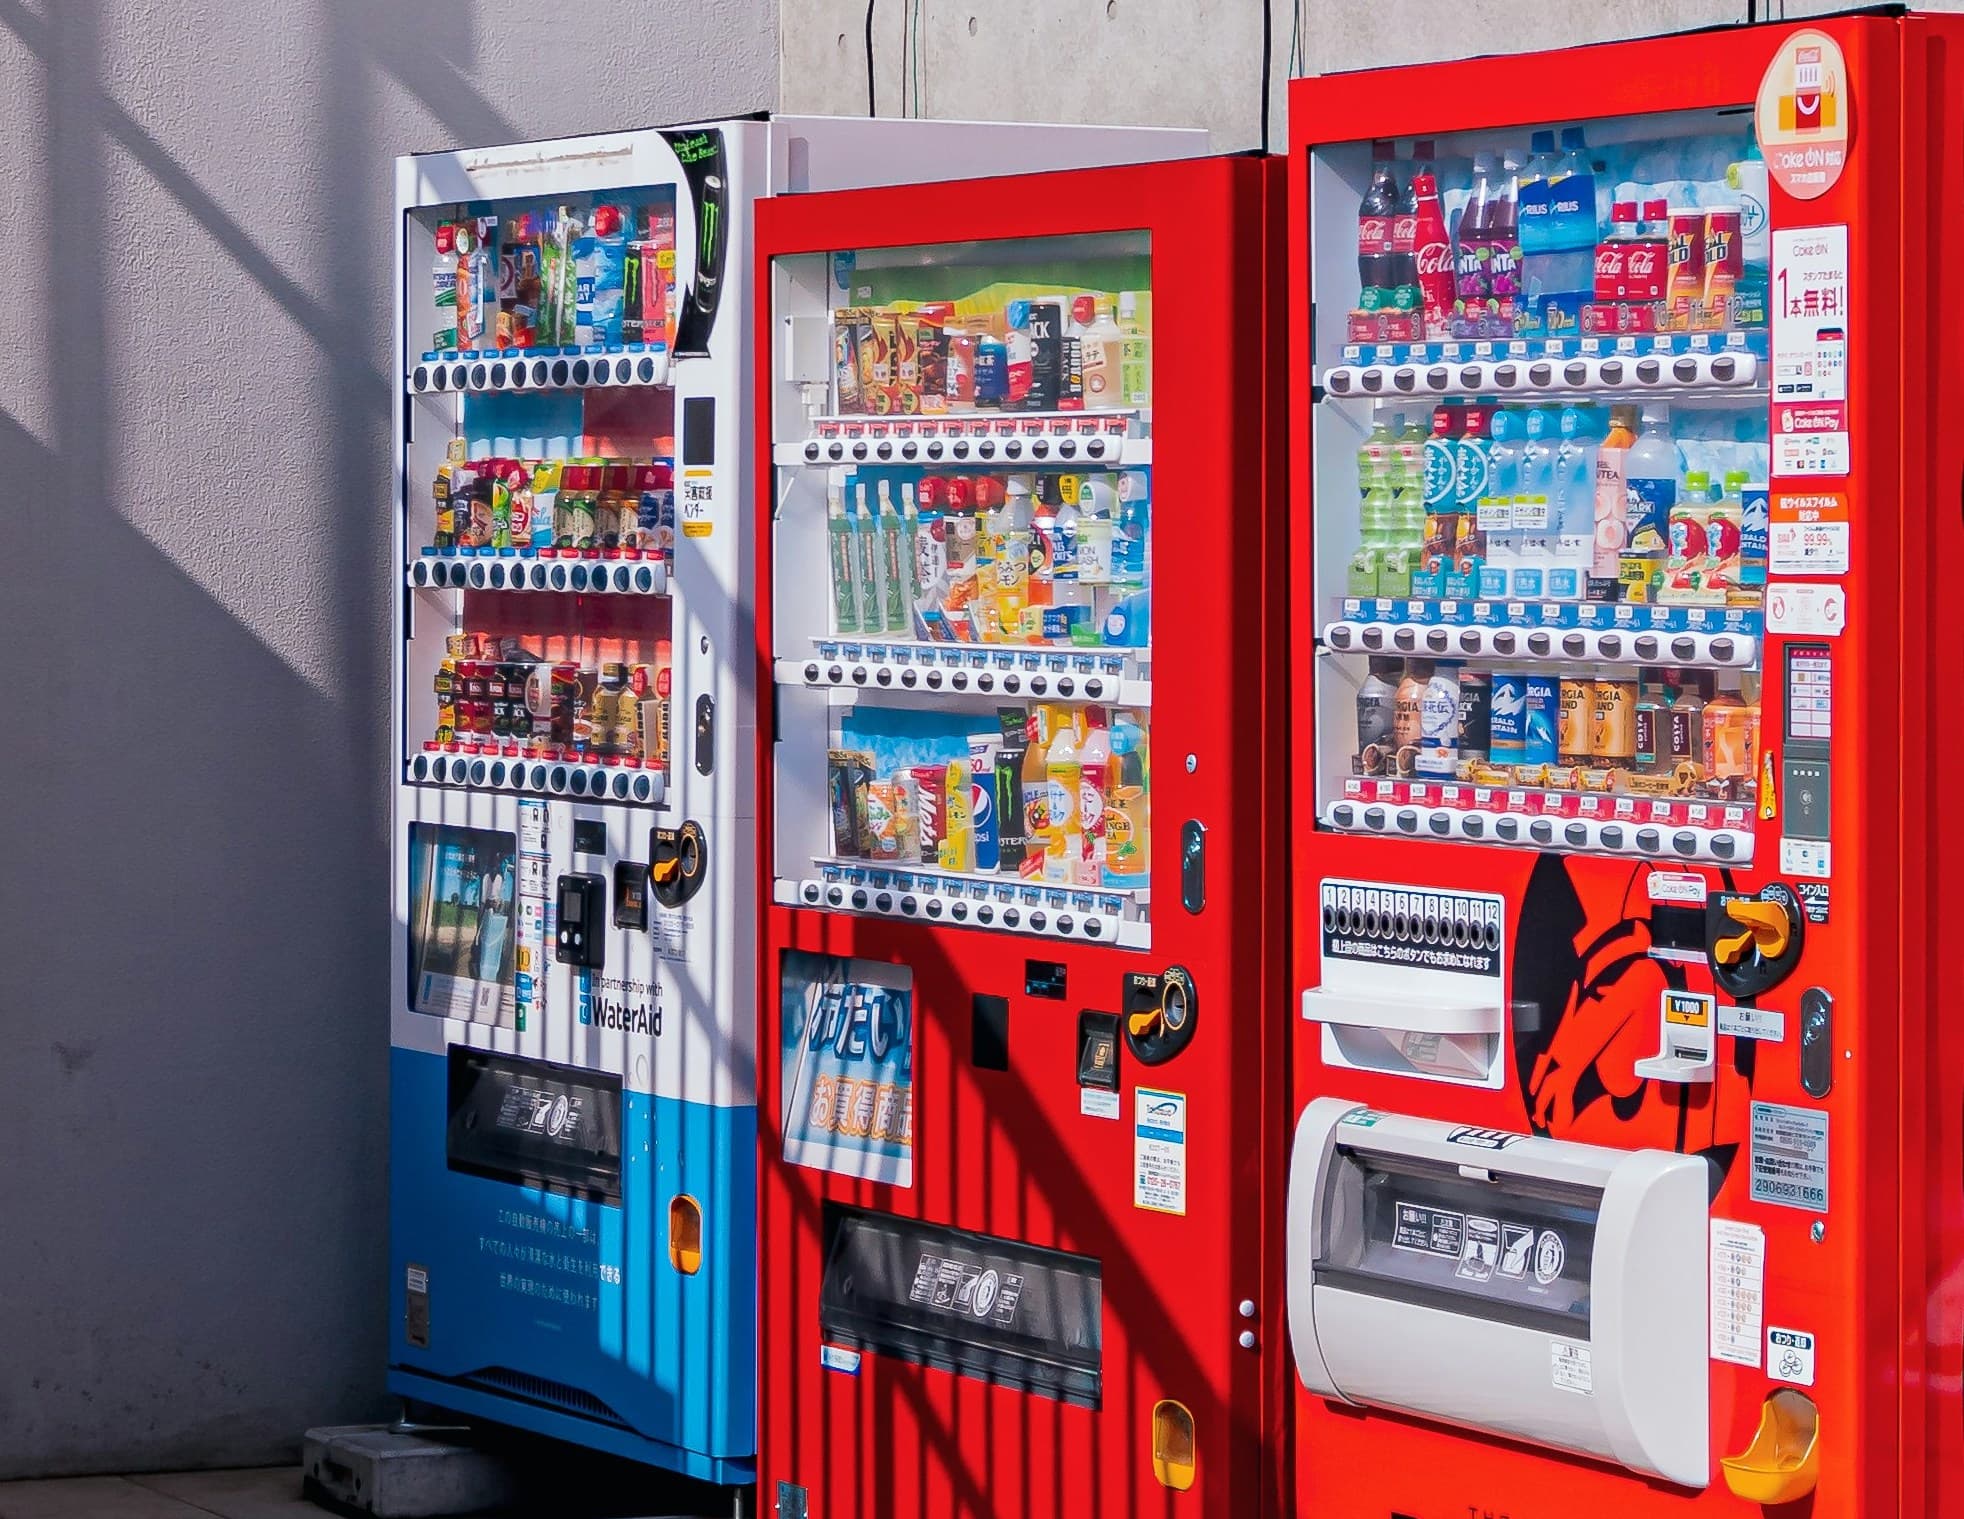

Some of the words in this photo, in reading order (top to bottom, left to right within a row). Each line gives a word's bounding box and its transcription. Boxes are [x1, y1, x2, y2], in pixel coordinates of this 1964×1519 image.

[1327, 889, 1332, 902] 1
[1341, 890, 1347, 904] 2
[1355, 891, 1361, 905] 3
[1370, 892, 1376, 906] 4
[1384, 893, 1391, 908] 5
[1400, 895, 1406, 909] 6
[1414, 896, 1420, 911] 7
[1429, 898, 1435, 913] 8
[1444, 900, 1450, 914] 9
[1457, 902, 1467, 916] 10
[1473, 904, 1481, 918] 11
[1488, 905, 1498, 919] 12
[601, 977, 644, 998] partnership
[646, 981, 663, 997] with
[592, 996, 662, 1037] WaterAid
